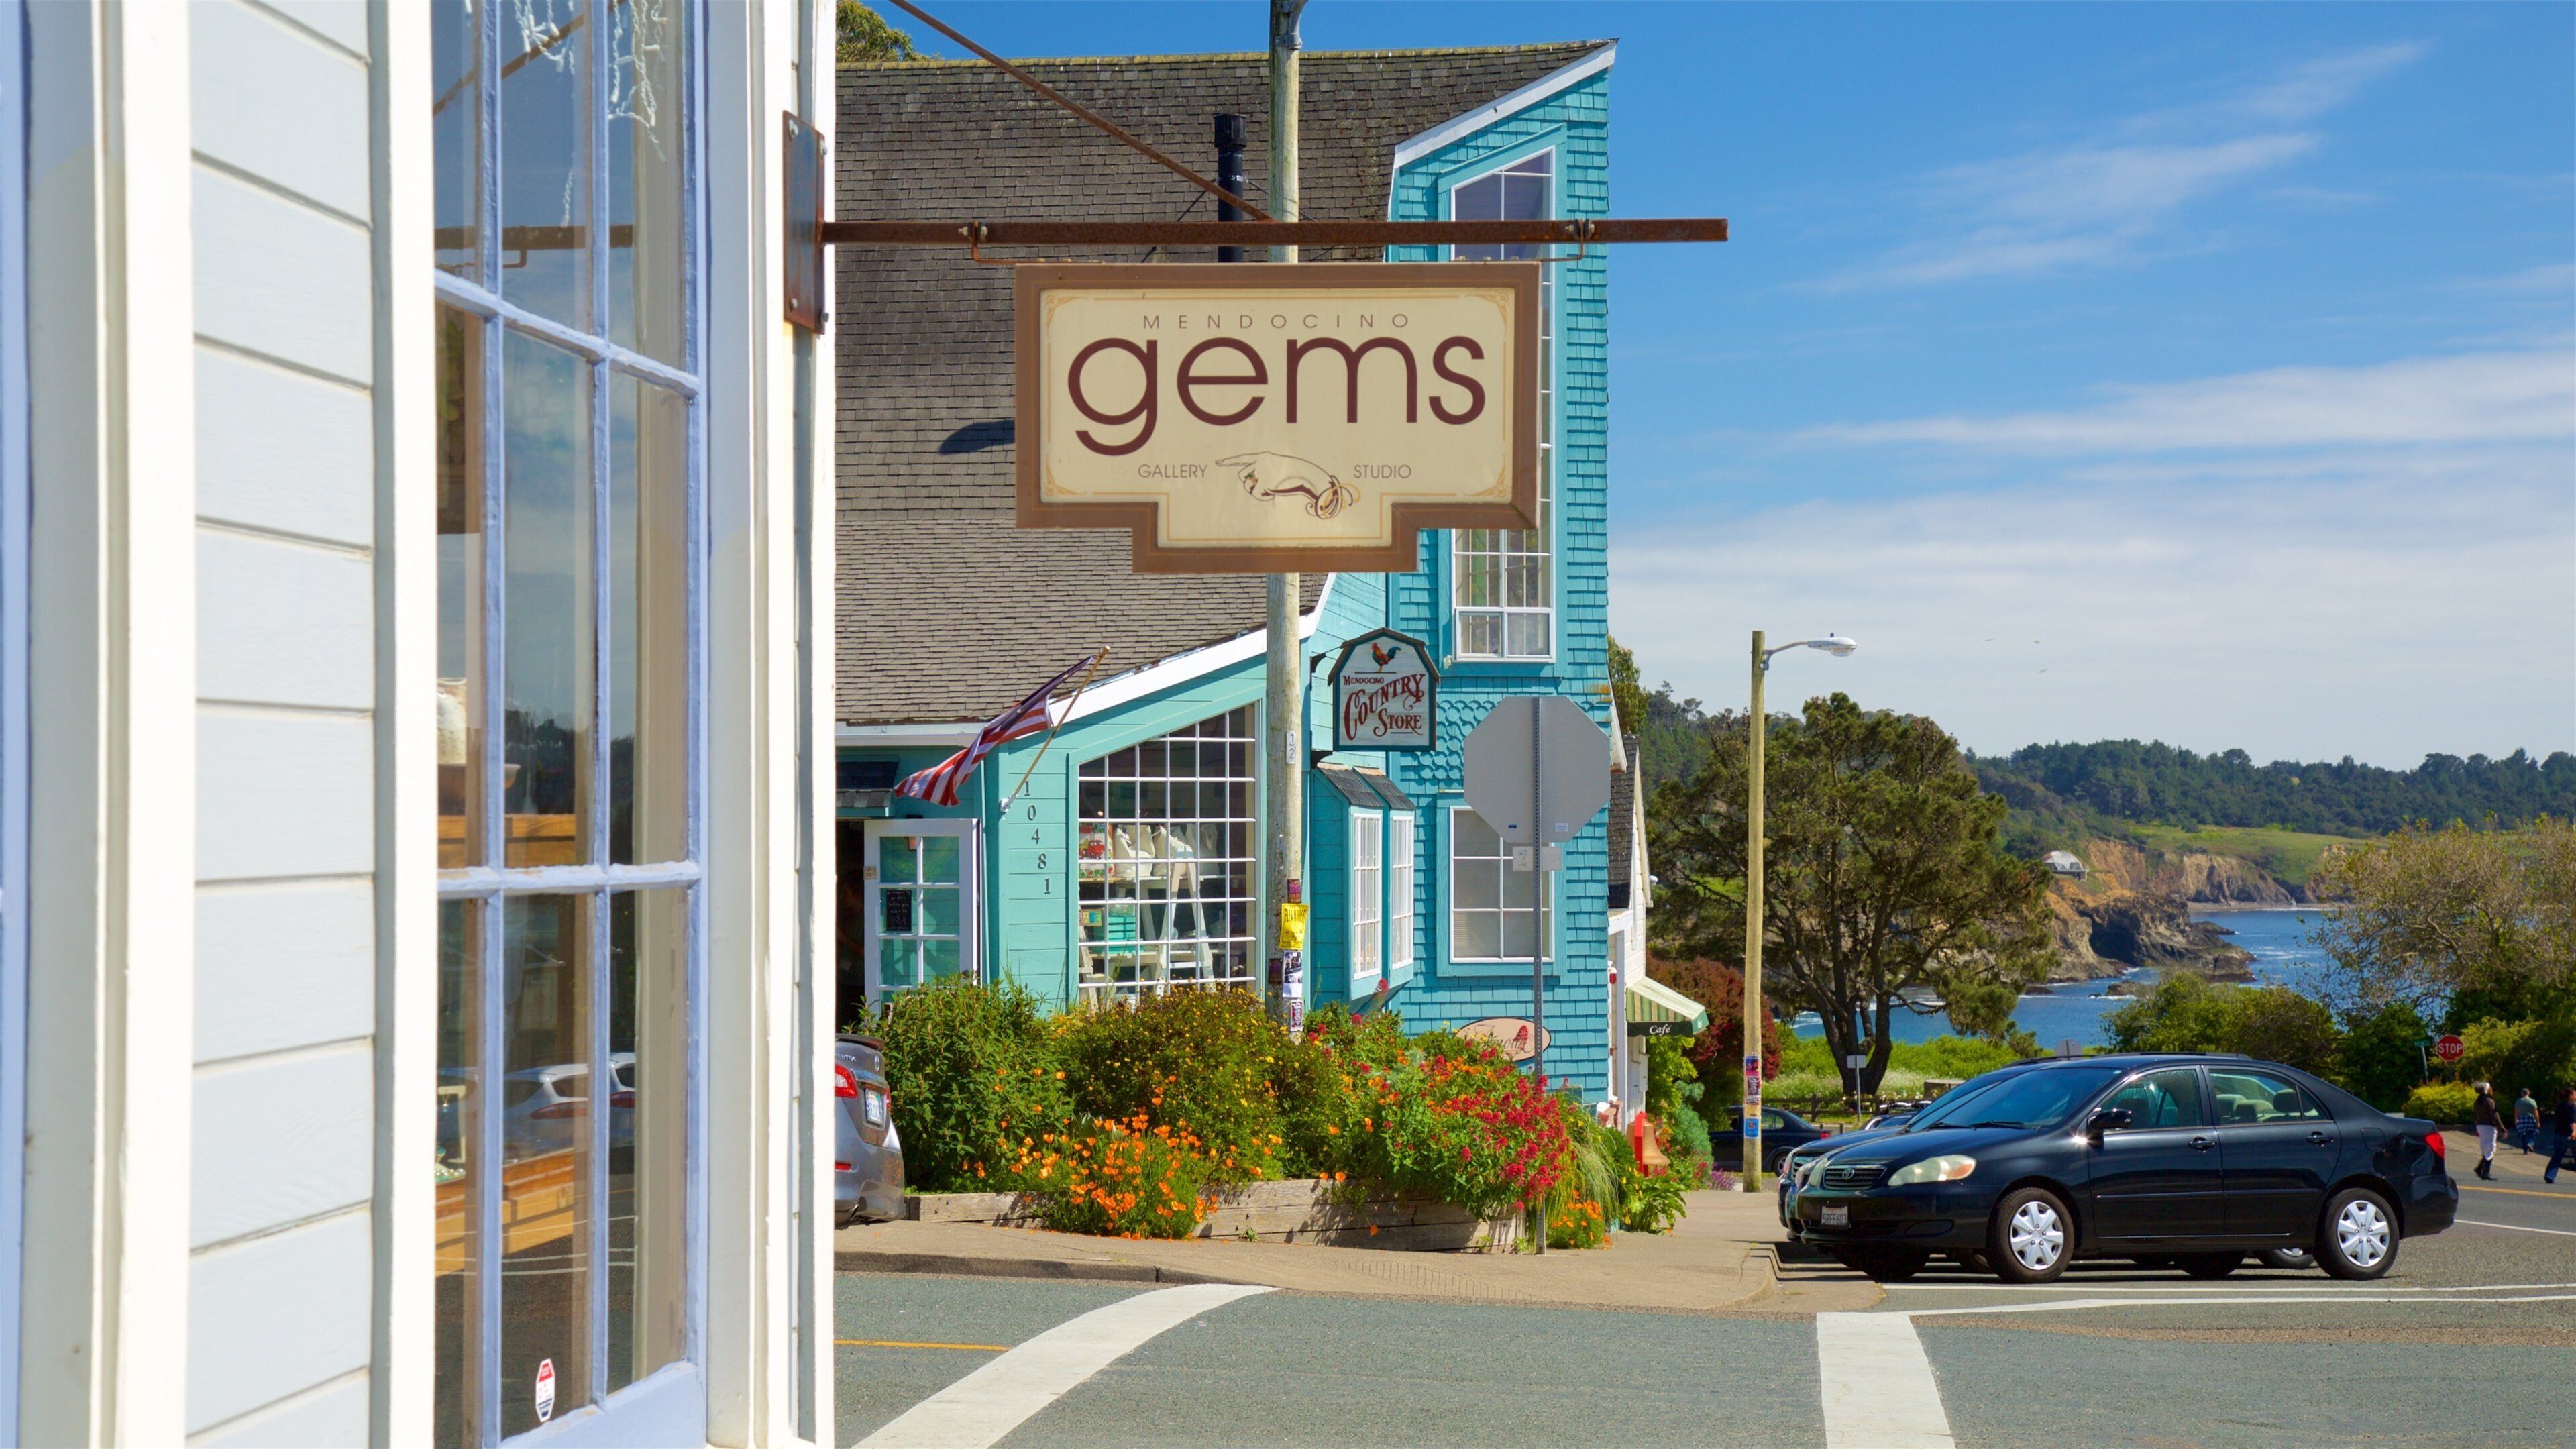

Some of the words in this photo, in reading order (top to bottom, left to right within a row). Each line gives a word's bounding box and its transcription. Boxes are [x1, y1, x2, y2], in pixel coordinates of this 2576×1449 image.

[1142, 313, 1409, 329] MENDOCINO
[1067, 335, 1487, 456] gems
[1138, 464, 1207, 479] GALLERY
[1354, 464, 1412, 479] STUDIO
[1342, 676, 1385, 685] MENDOCINO
[1344, 674, 1426, 741] COUNTRY
[1373, 708, 1423, 737] STORE
[1650, 1024, 1672, 1036] Café
[2438, 1043, 2463, 1054] STOP
